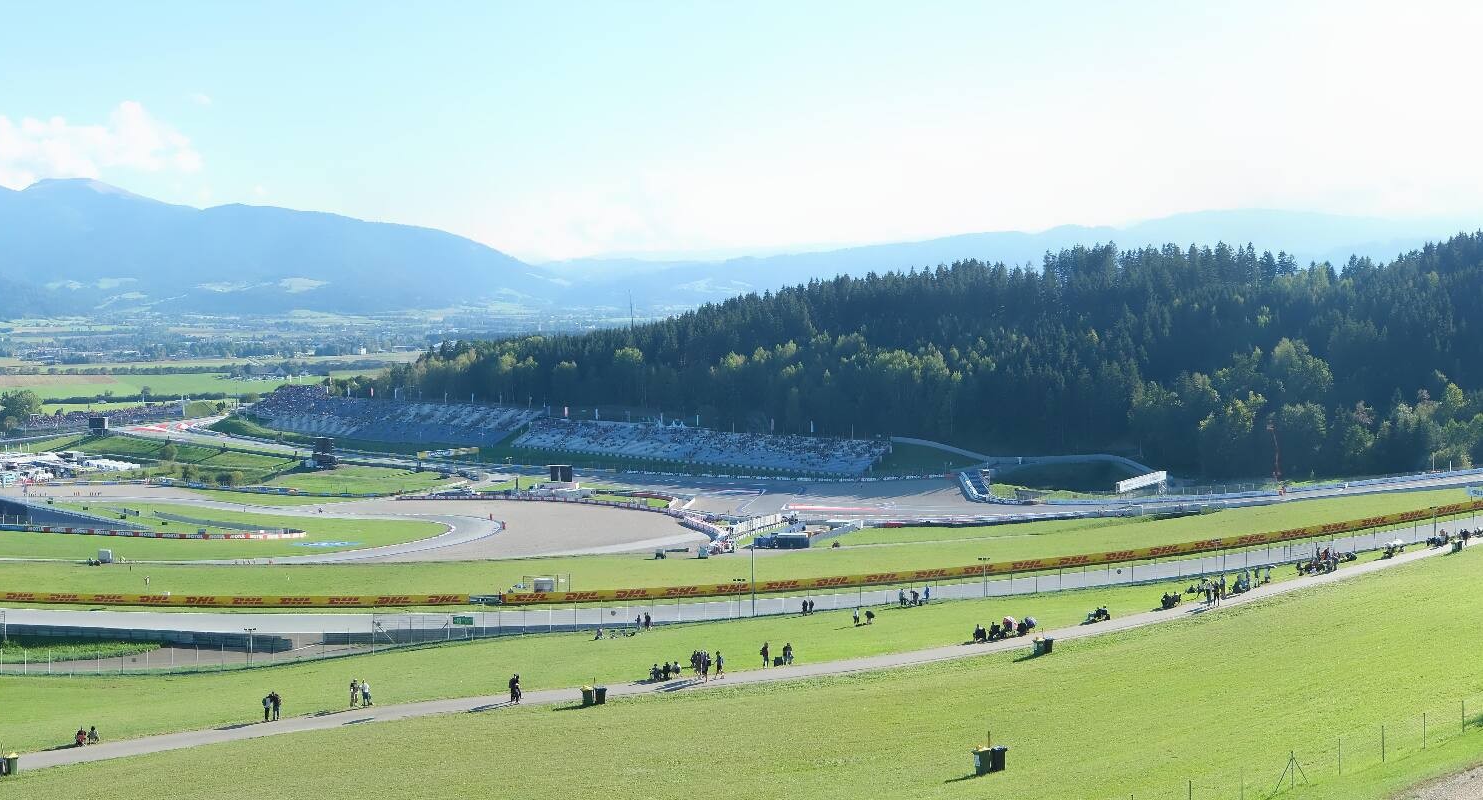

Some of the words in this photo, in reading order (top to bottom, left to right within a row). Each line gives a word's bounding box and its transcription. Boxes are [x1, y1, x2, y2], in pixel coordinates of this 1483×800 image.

[429, 595, 461, 603] DHL
[515, 593, 547, 601] DHL
[566, 591, 599, 600] DHL
[616, 589, 648, 598] DHL
[666, 586, 699, 595] DHL
[716, 583, 750, 592] DHL
[766, 580, 800, 589] DHL
[816, 577, 849, 587] DHL
[865, 573, 899, 583] DHL
[915, 569, 948, 579] DHL
[963, 565, 995, 574] DHL
[1012, 560, 1043, 570] DHL
[1059, 555, 1090, 565] DHL
[1105, 550, 1136, 560] DHL
[1149, 545, 1180, 555] DHL
